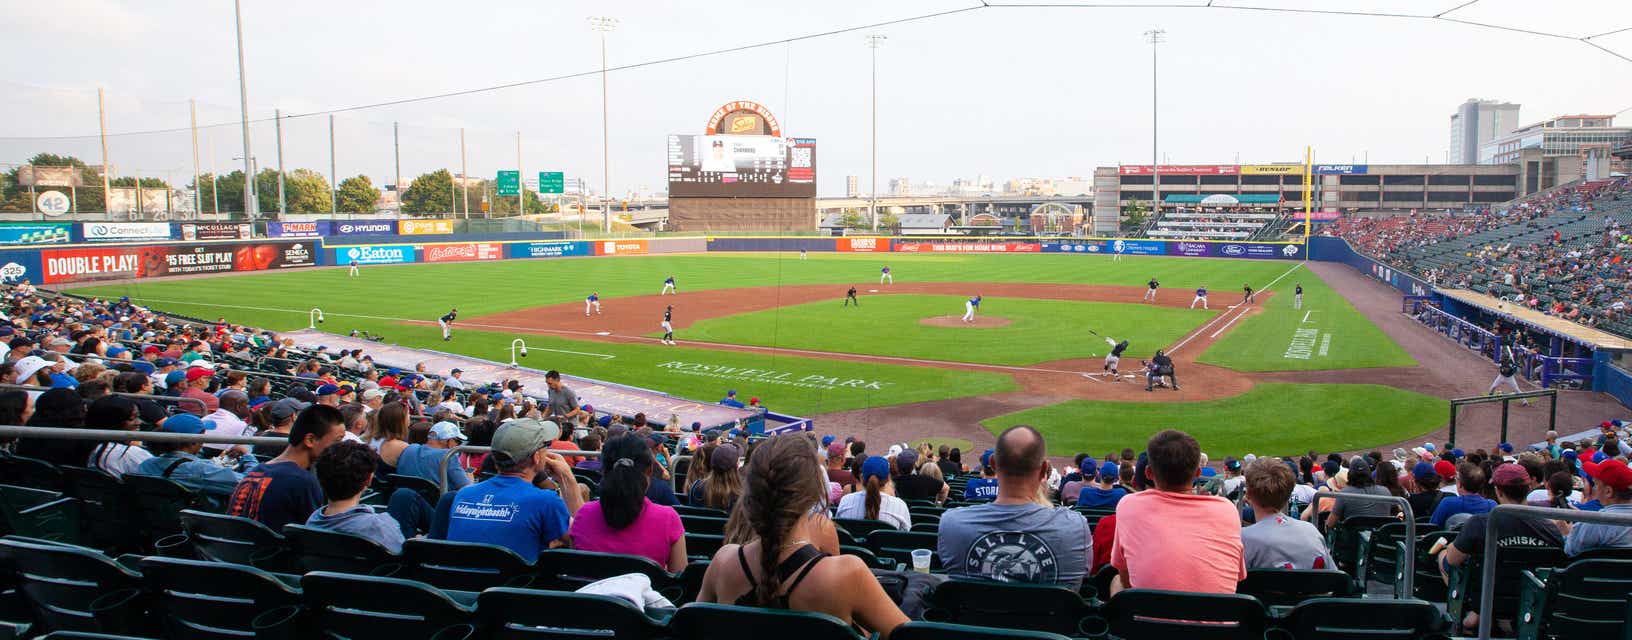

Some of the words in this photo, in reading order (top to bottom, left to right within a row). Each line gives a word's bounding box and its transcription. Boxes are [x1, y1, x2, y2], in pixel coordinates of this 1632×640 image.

[738, 101, 756, 110] THE
[42, 197, 64, 211] 42
[354, 223, 391, 232] HYUNDAI
[360, 246, 403, 259] Eaton
[1226, 245, 1242, 254] Ford
[47, 256, 100, 276] DOUBLE
[102, 254, 139, 273] PLAY!
[165, 254, 178, 266] $15
[178, 254, 197, 265] FREE
[197, 253, 214, 264] SLOT
[215, 252, 233, 263] PLAY
[4, 267, 22, 275] 325
[656, 361, 792, 380] ROSWELL
[799, 374, 881, 390] PARK
[969, 533, 1005, 568] SALT
[1018, 533, 1053, 568] LFE
